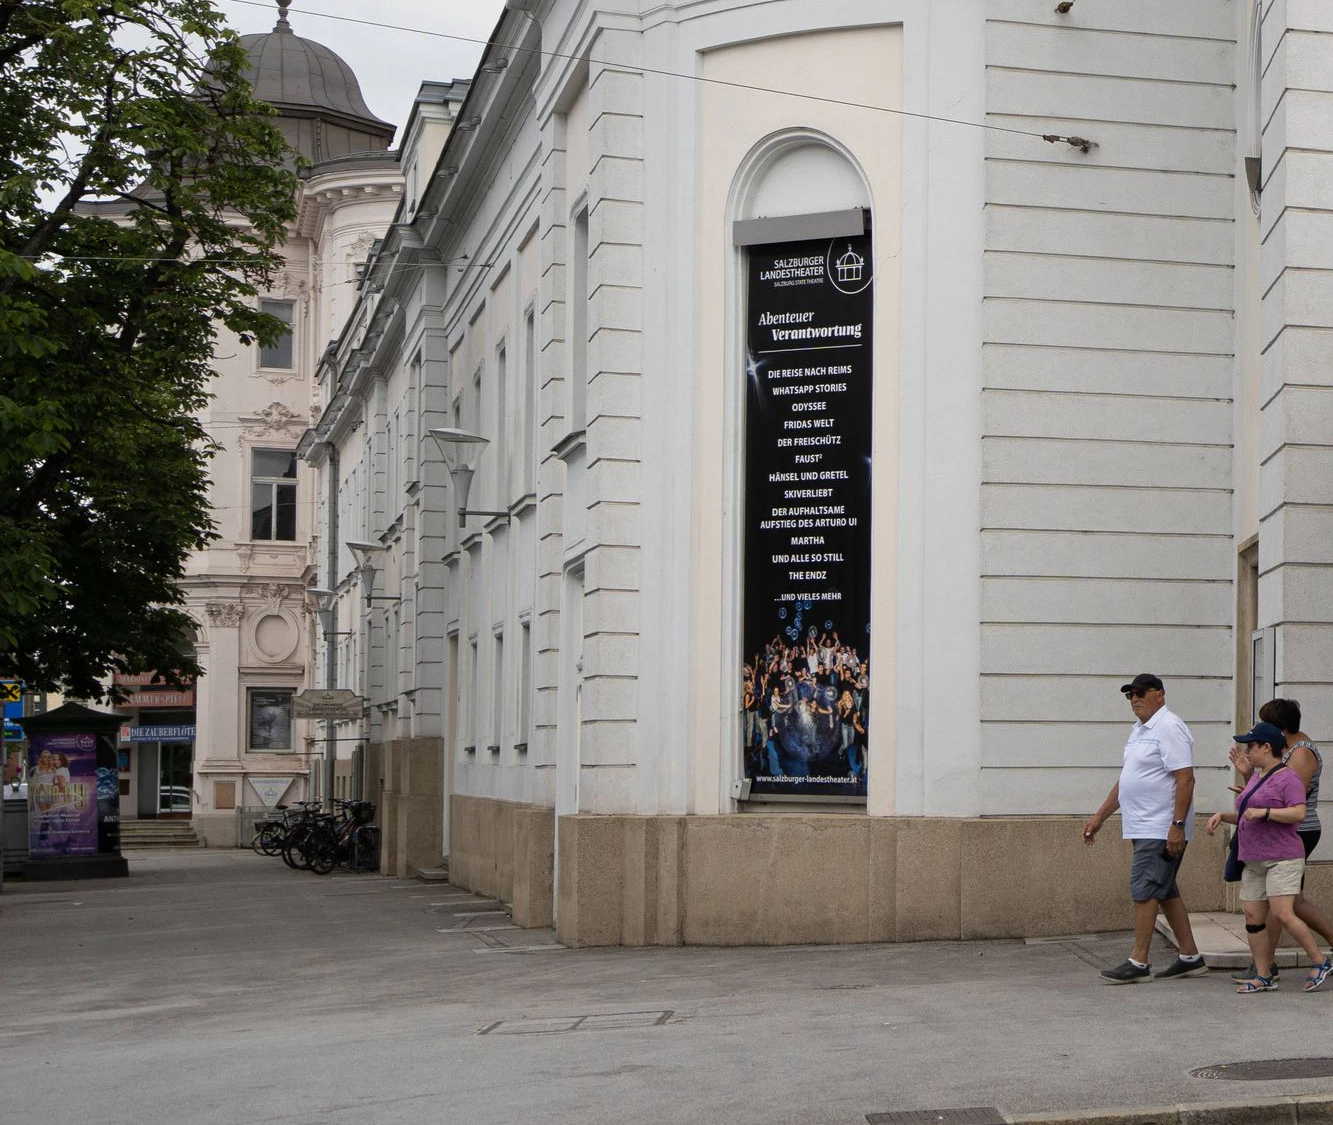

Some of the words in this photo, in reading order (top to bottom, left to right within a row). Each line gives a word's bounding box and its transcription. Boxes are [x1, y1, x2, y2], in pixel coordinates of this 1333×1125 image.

[774, 255, 824, 269] SALZBURGER
[760, 266, 824, 281] LANDESTHEATER
[758, 311, 815, 326] Abenteuer
[772, 323, 862, 341] Verantwortung
[768, 369, 781, 379] DIE
[782, 368, 803, 378] REISE
[804, 367, 826, 377] NACH
[828, 365, 852, 375] REIMS
[772, 385, 814, 396] WHATSAPP
[815, 383, 847, 393] STORIES
[791, 401, 827, 412] ODYSSEE
[784, 419, 812, 430] FRIDAS
[813, 418, 835, 428] WELT
[777, 438, 792, 448] DER
[794, 434, 841, 446] FREISCHÜTZ
[769, 471, 799, 482] HÄNSEL
[800, 471, 818, 481] UND
[819, 470, 849, 480] GRETEL
[784, 488, 833, 499] SKIVERLIEBT
[772, 507, 787, 517] DER
[788, 505, 845, 516] AUFHALTSAME
[760, 519, 797, 529] AUFSTIEG
[798, 519, 813, 528] DES
[815, 517, 847, 527] ARTURO
[848, 517, 857, 527] UI
[790, 536, 825, 546] MARTHA
[772, 554, 789, 564] UND
[790, 554, 810, 563] ALLE
[811, 553, 822, 563] SO
[823, 553, 844, 562] STILL
[788, 571, 804, 580] THE
[805, 570, 827, 580] ENDZ
[796, 593, 820, 601] VIELES
[821, 592, 842, 601] MEHR
[131, 727, 144, 737] DIE
[145, 725, 196, 737] ZAUBERFLÖTE
[756, 774, 858, 784] www.salzburger-landestheater.at
